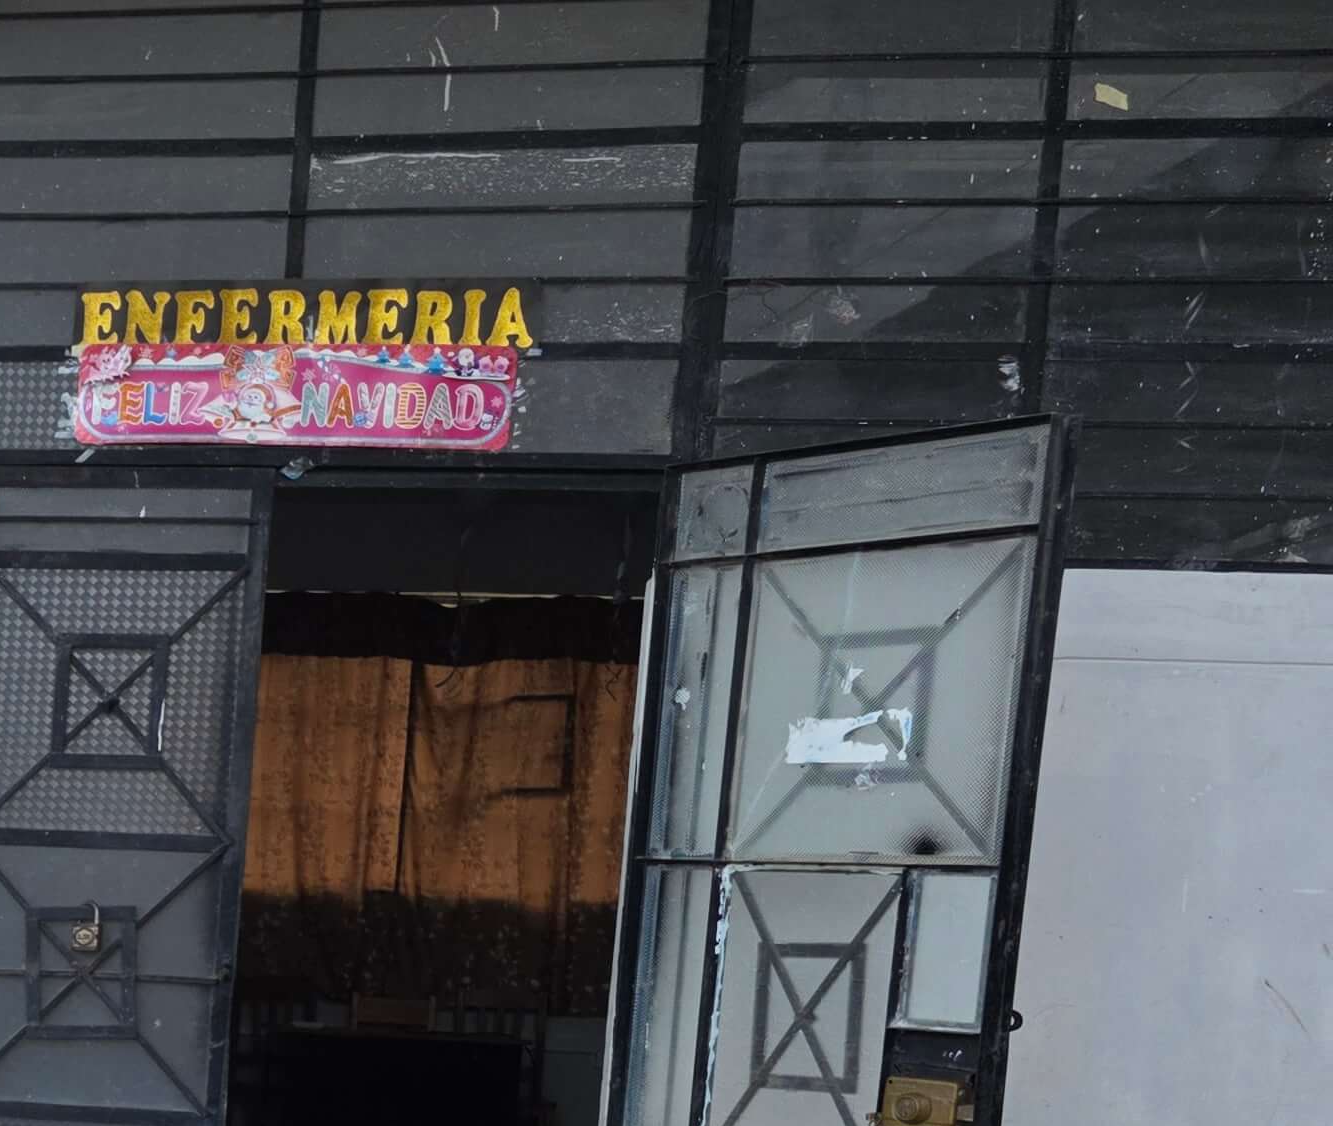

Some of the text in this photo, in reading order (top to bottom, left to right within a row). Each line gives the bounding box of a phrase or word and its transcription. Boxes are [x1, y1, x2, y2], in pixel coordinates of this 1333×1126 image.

[81, 287, 534, 348] ENFERMERIA
[90, 381, 485, 431] FELIZ NAVIDAD
